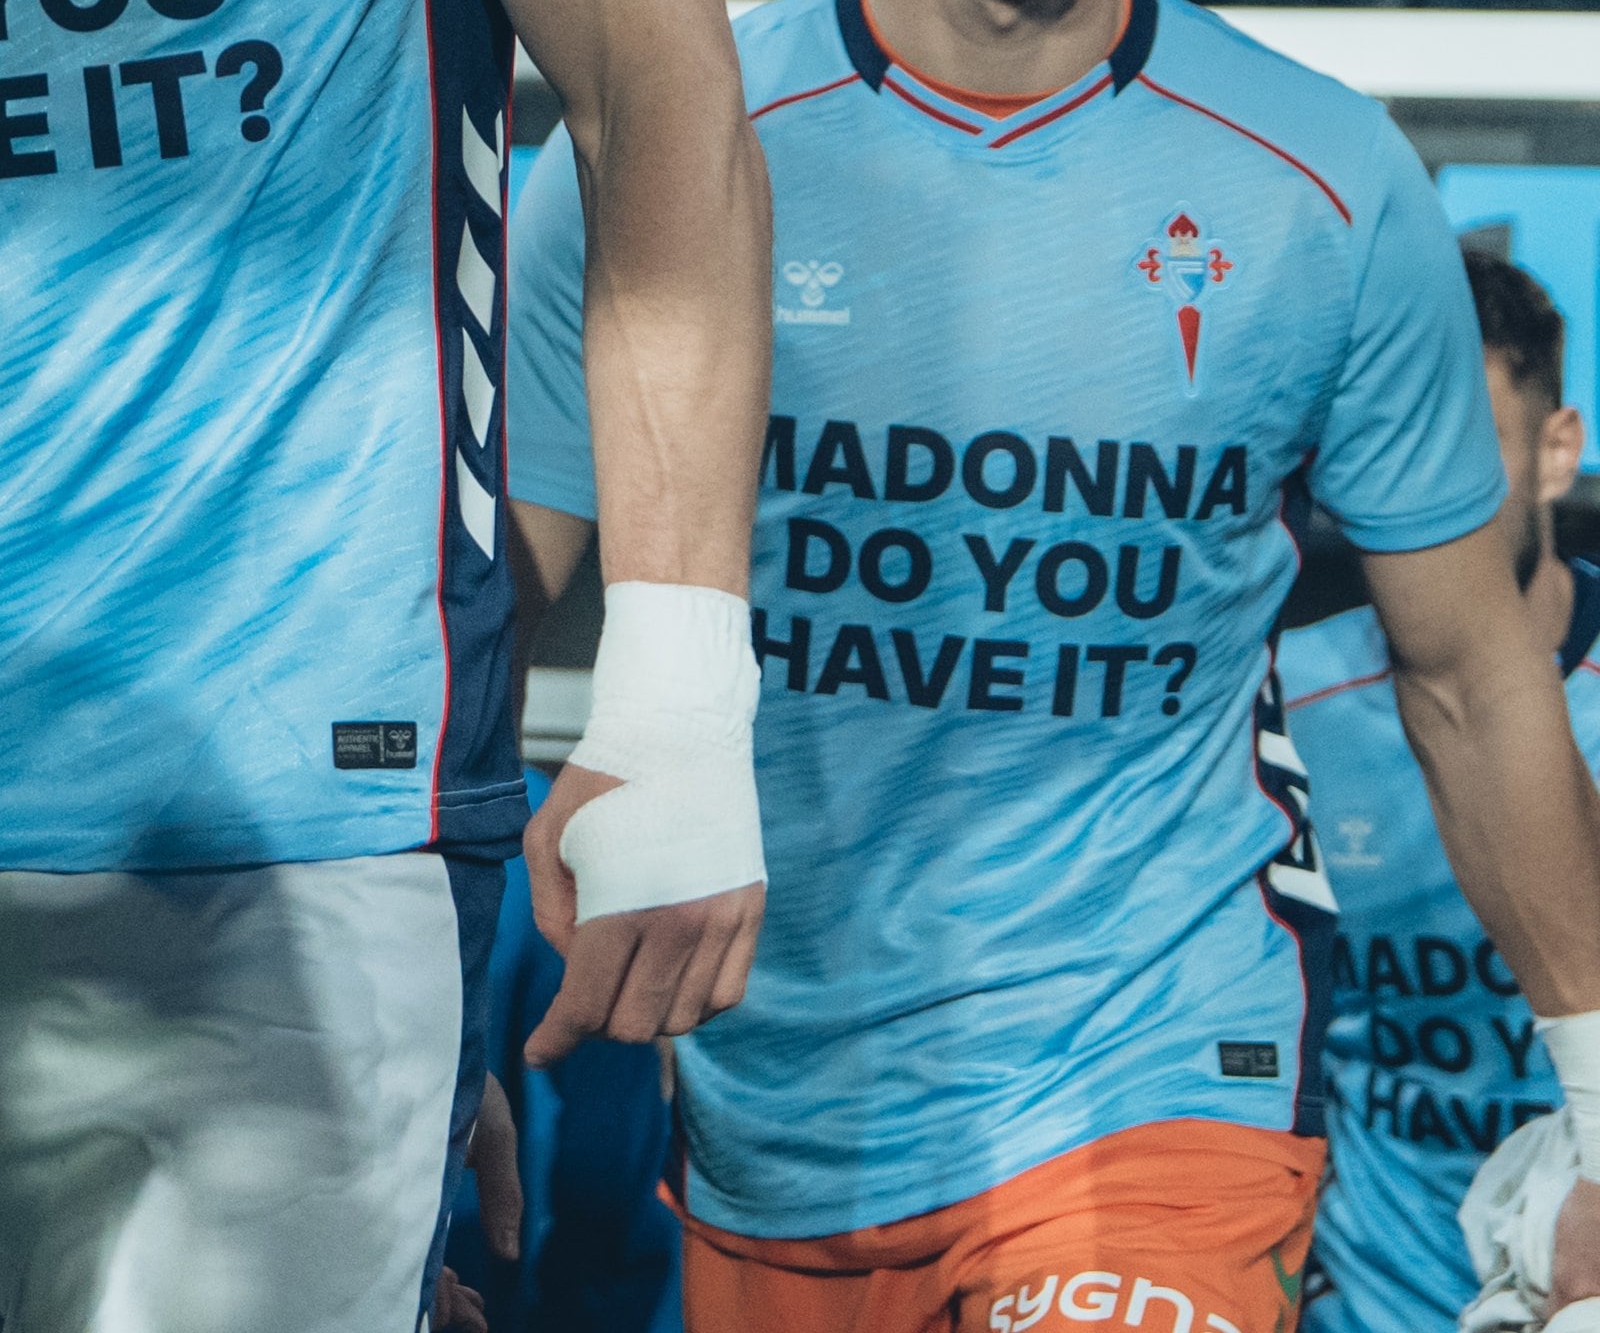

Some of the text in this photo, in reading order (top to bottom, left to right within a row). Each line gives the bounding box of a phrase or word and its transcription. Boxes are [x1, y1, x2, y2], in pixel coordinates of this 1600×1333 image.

[83, 39, 284, 170] IT?
[776, 305, 851, 326] hummel
[784, 513, 1183, 620] DO YOU
[751, 606, 1199, 719] HAVE IT?
[1370, 1013, 1474, 1073] DO
